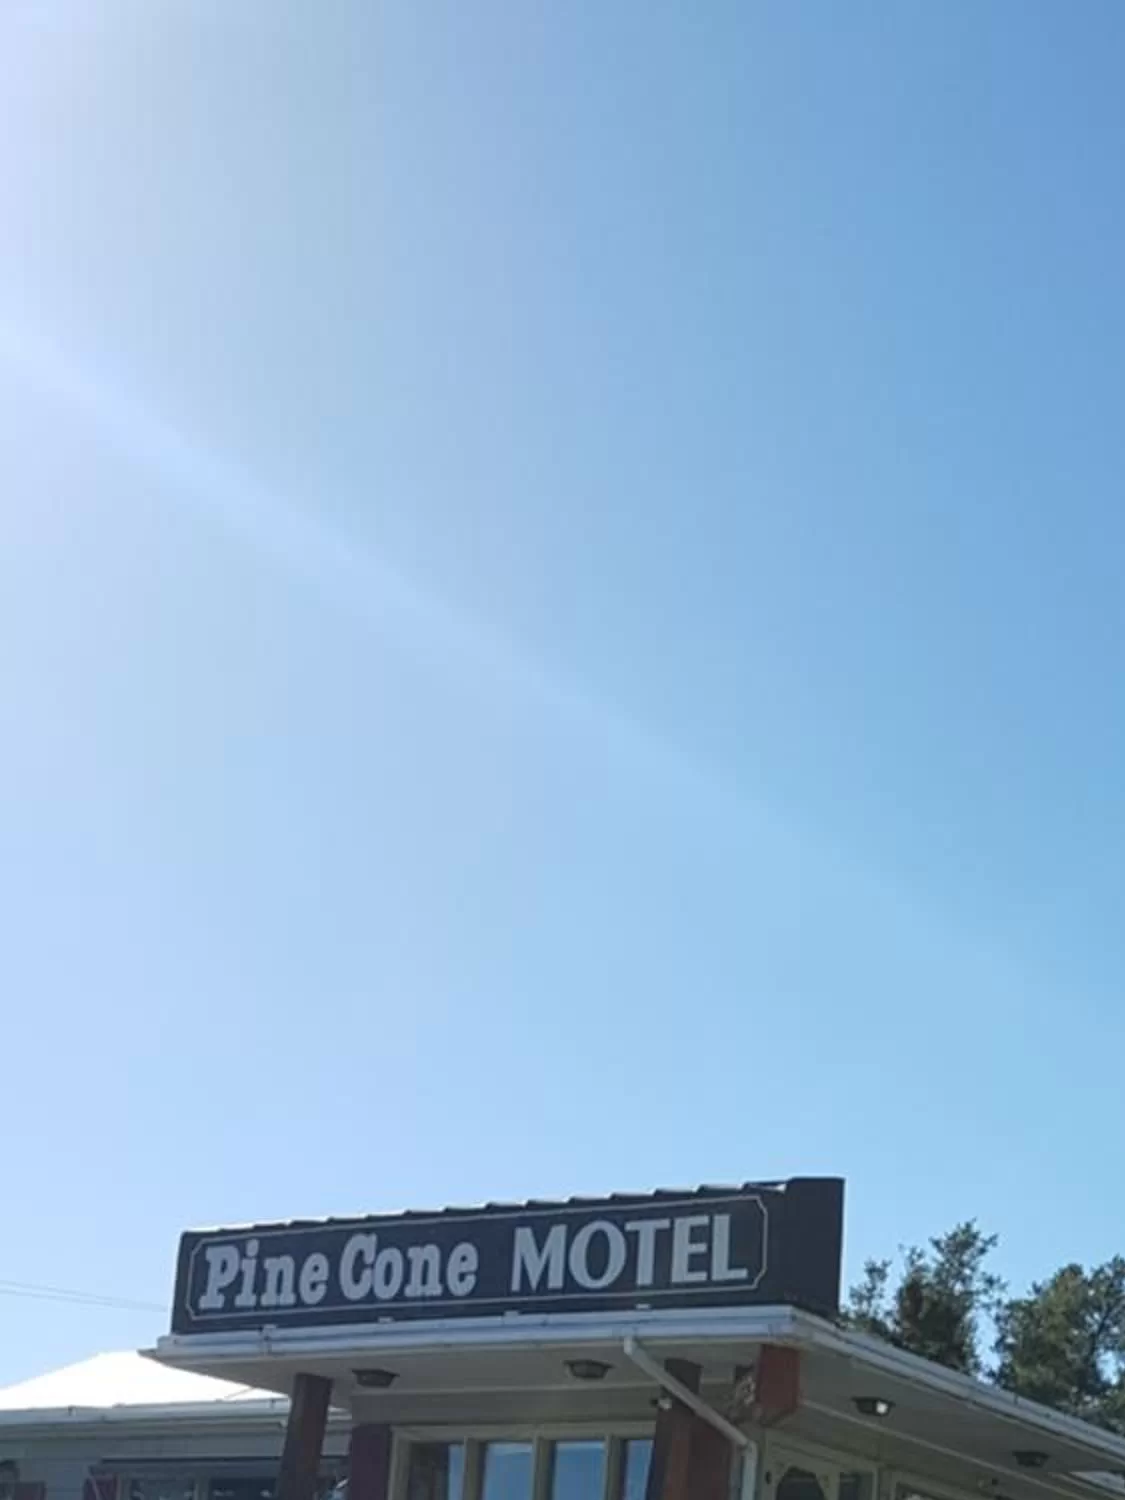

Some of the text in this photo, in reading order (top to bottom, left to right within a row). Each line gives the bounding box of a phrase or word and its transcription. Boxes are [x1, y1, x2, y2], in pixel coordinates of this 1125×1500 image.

[199, 1213, 748, 1310] Pine Cone MOTEL
